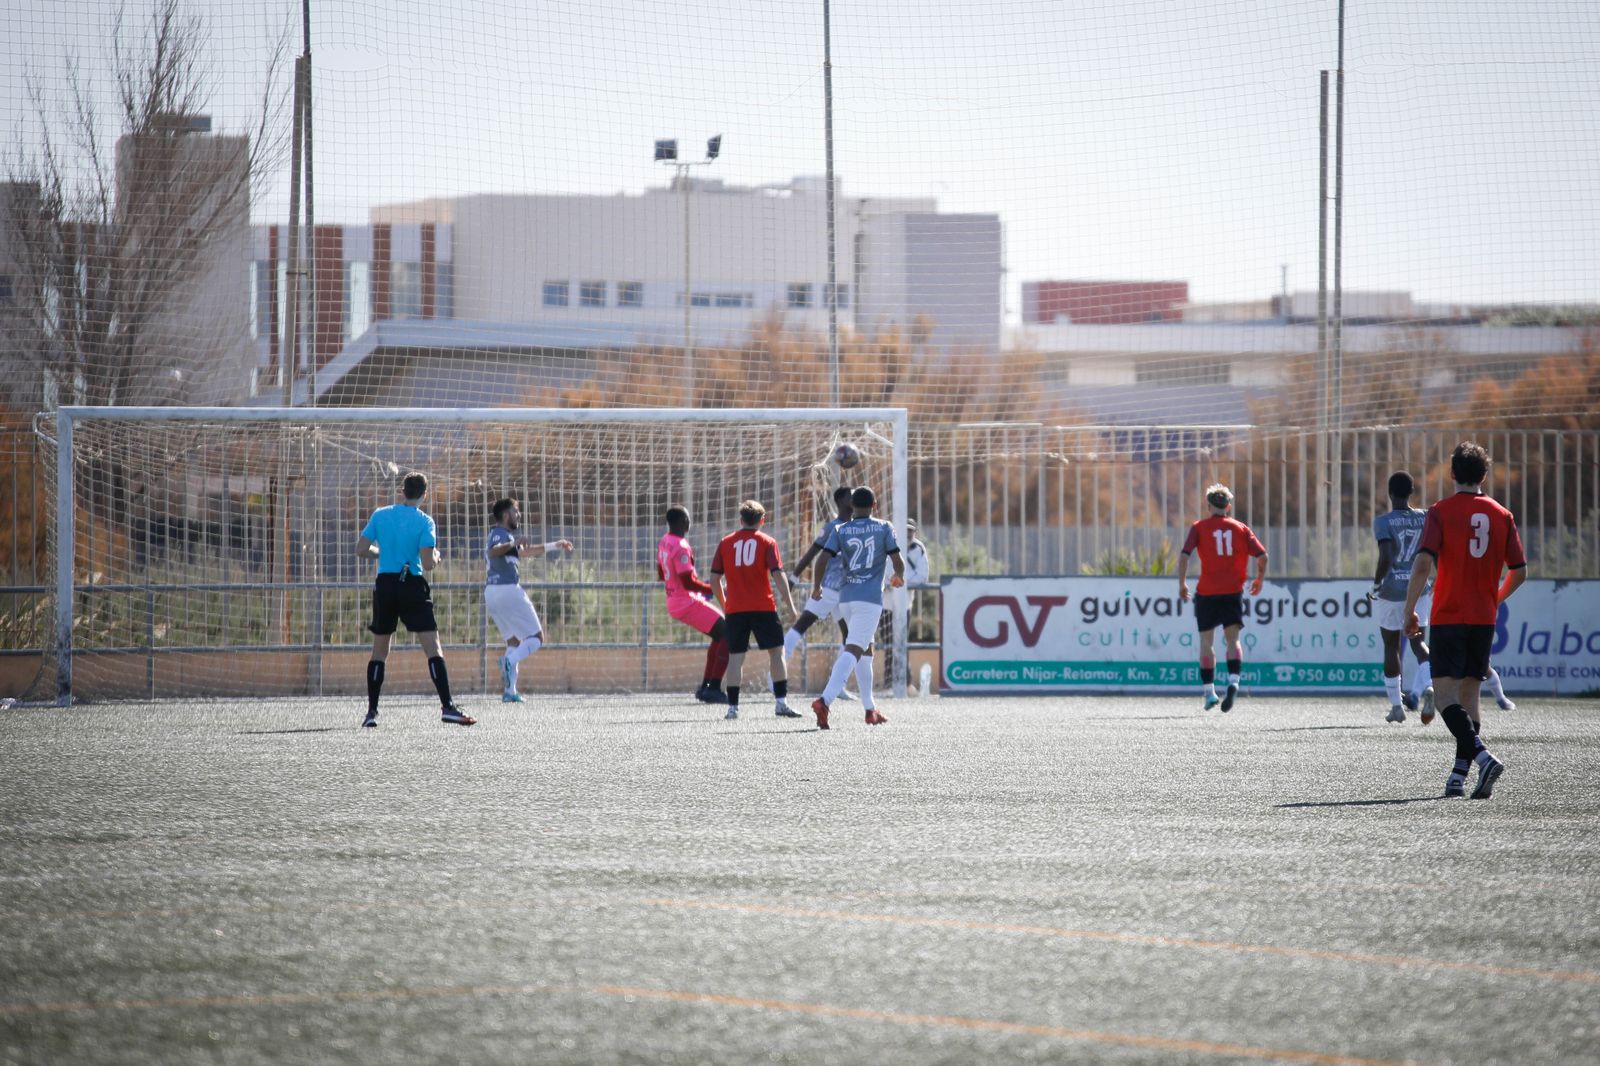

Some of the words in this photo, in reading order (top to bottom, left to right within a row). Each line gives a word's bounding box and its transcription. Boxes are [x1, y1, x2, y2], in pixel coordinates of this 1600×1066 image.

[1212, 529, 1233, 556] 11
[1396, 529, 1422, 562] 17
[1469, 512, 1490, 558] 3
[733, 538, 757, 567] 10
[847, 535, 875, 571] 21
[1277, 629, 1377, 652] juntos
[951, 666, 1018, 680] Carretera
[1127, 668, 1154, 681] Km.
[1298, 668, 1324, 682] 950
[1328, 668, 1346, 682] 60
[1349, 669, 1367, 682] 02
[1547, 667, 1567, 678] DE
